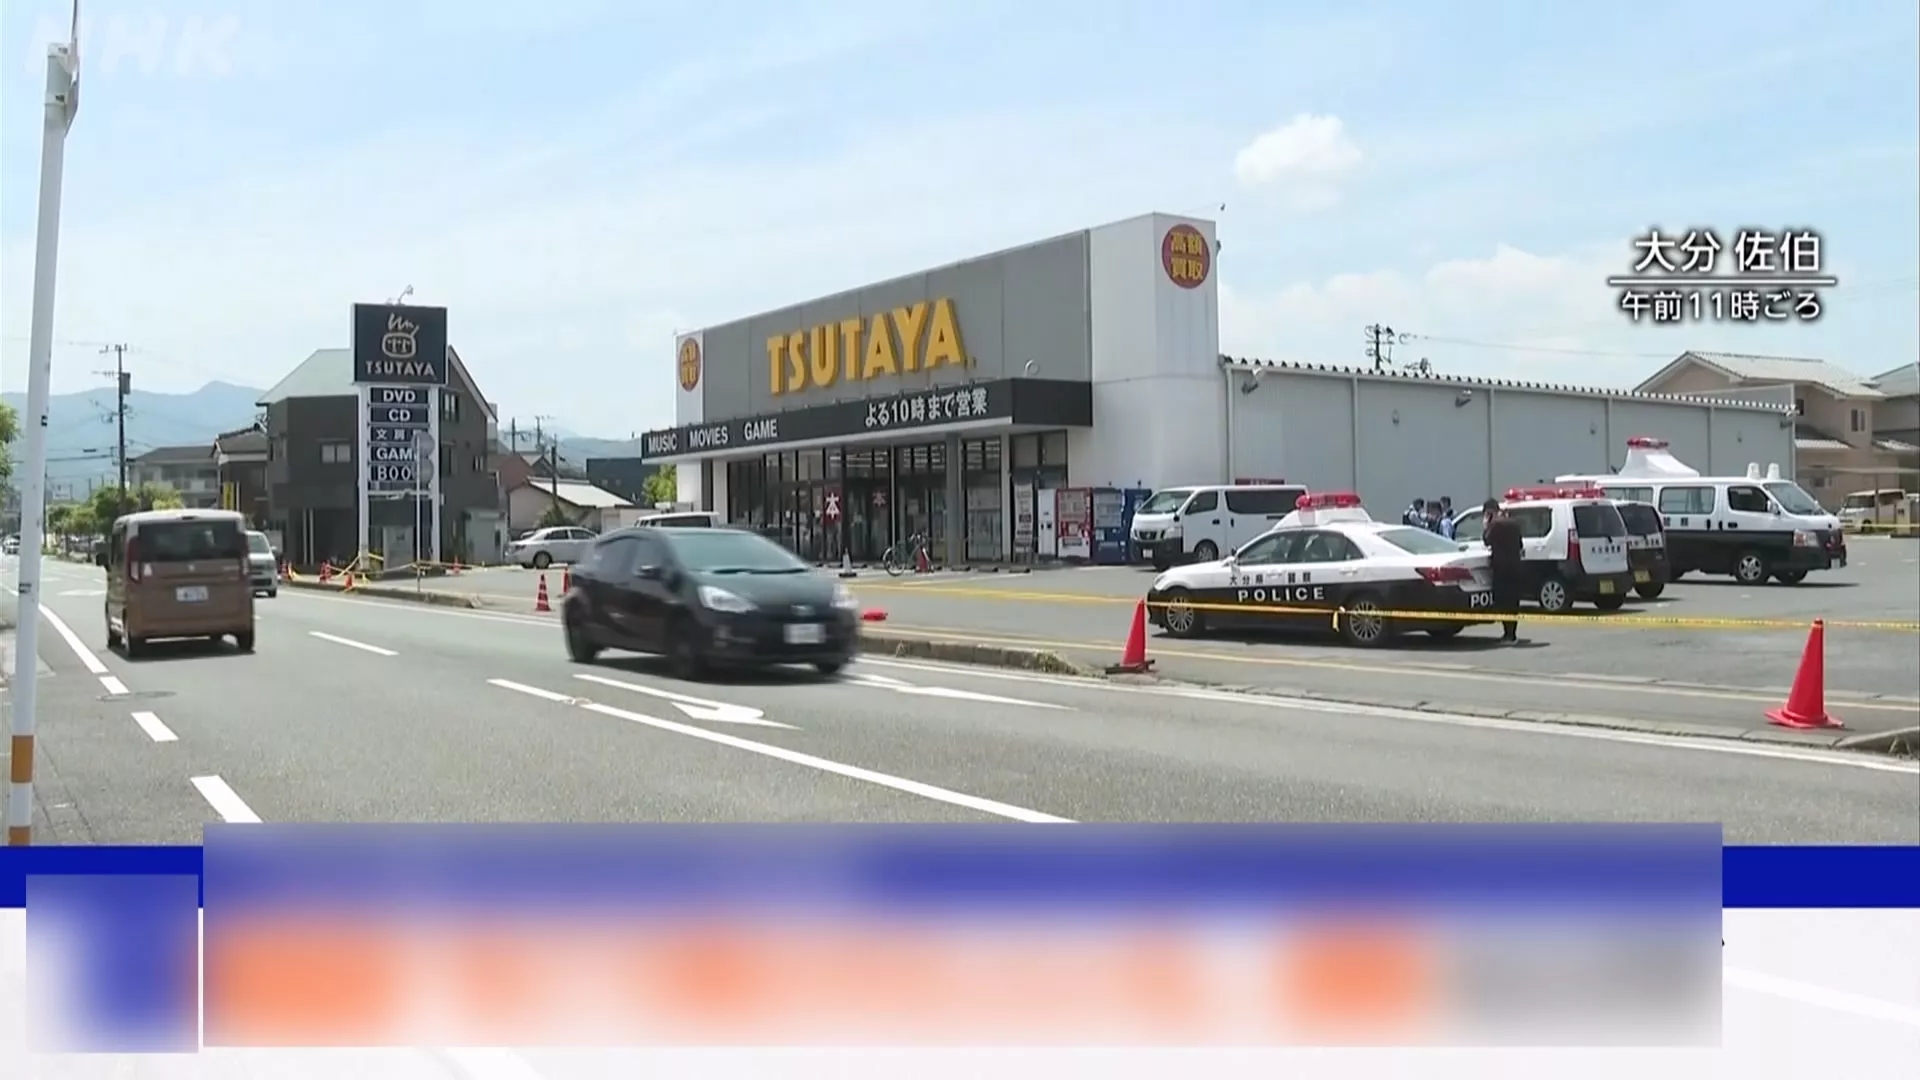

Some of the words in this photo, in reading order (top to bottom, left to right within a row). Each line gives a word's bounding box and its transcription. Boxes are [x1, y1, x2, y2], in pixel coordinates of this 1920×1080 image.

[767, 298, 967, 397] TSUTAYA
[365, 361, 437, 380] TSUTAYA
[383, 389, 416, 402] DVD
[388, 408, 411, 421] CD
[865, 387, 988, 427] よる10時まで営業
[648, 433, 678, 454] MUSIC
[689, 426, 729, 449] MOVIES
[744, 419, 778, 440] GAME
[376, 447, 417, 460] GAM
[379, 466, 412, 481] BOO
[825, 491, 841, 520] 本
[1237, 587, 1325, 602] POLICE
